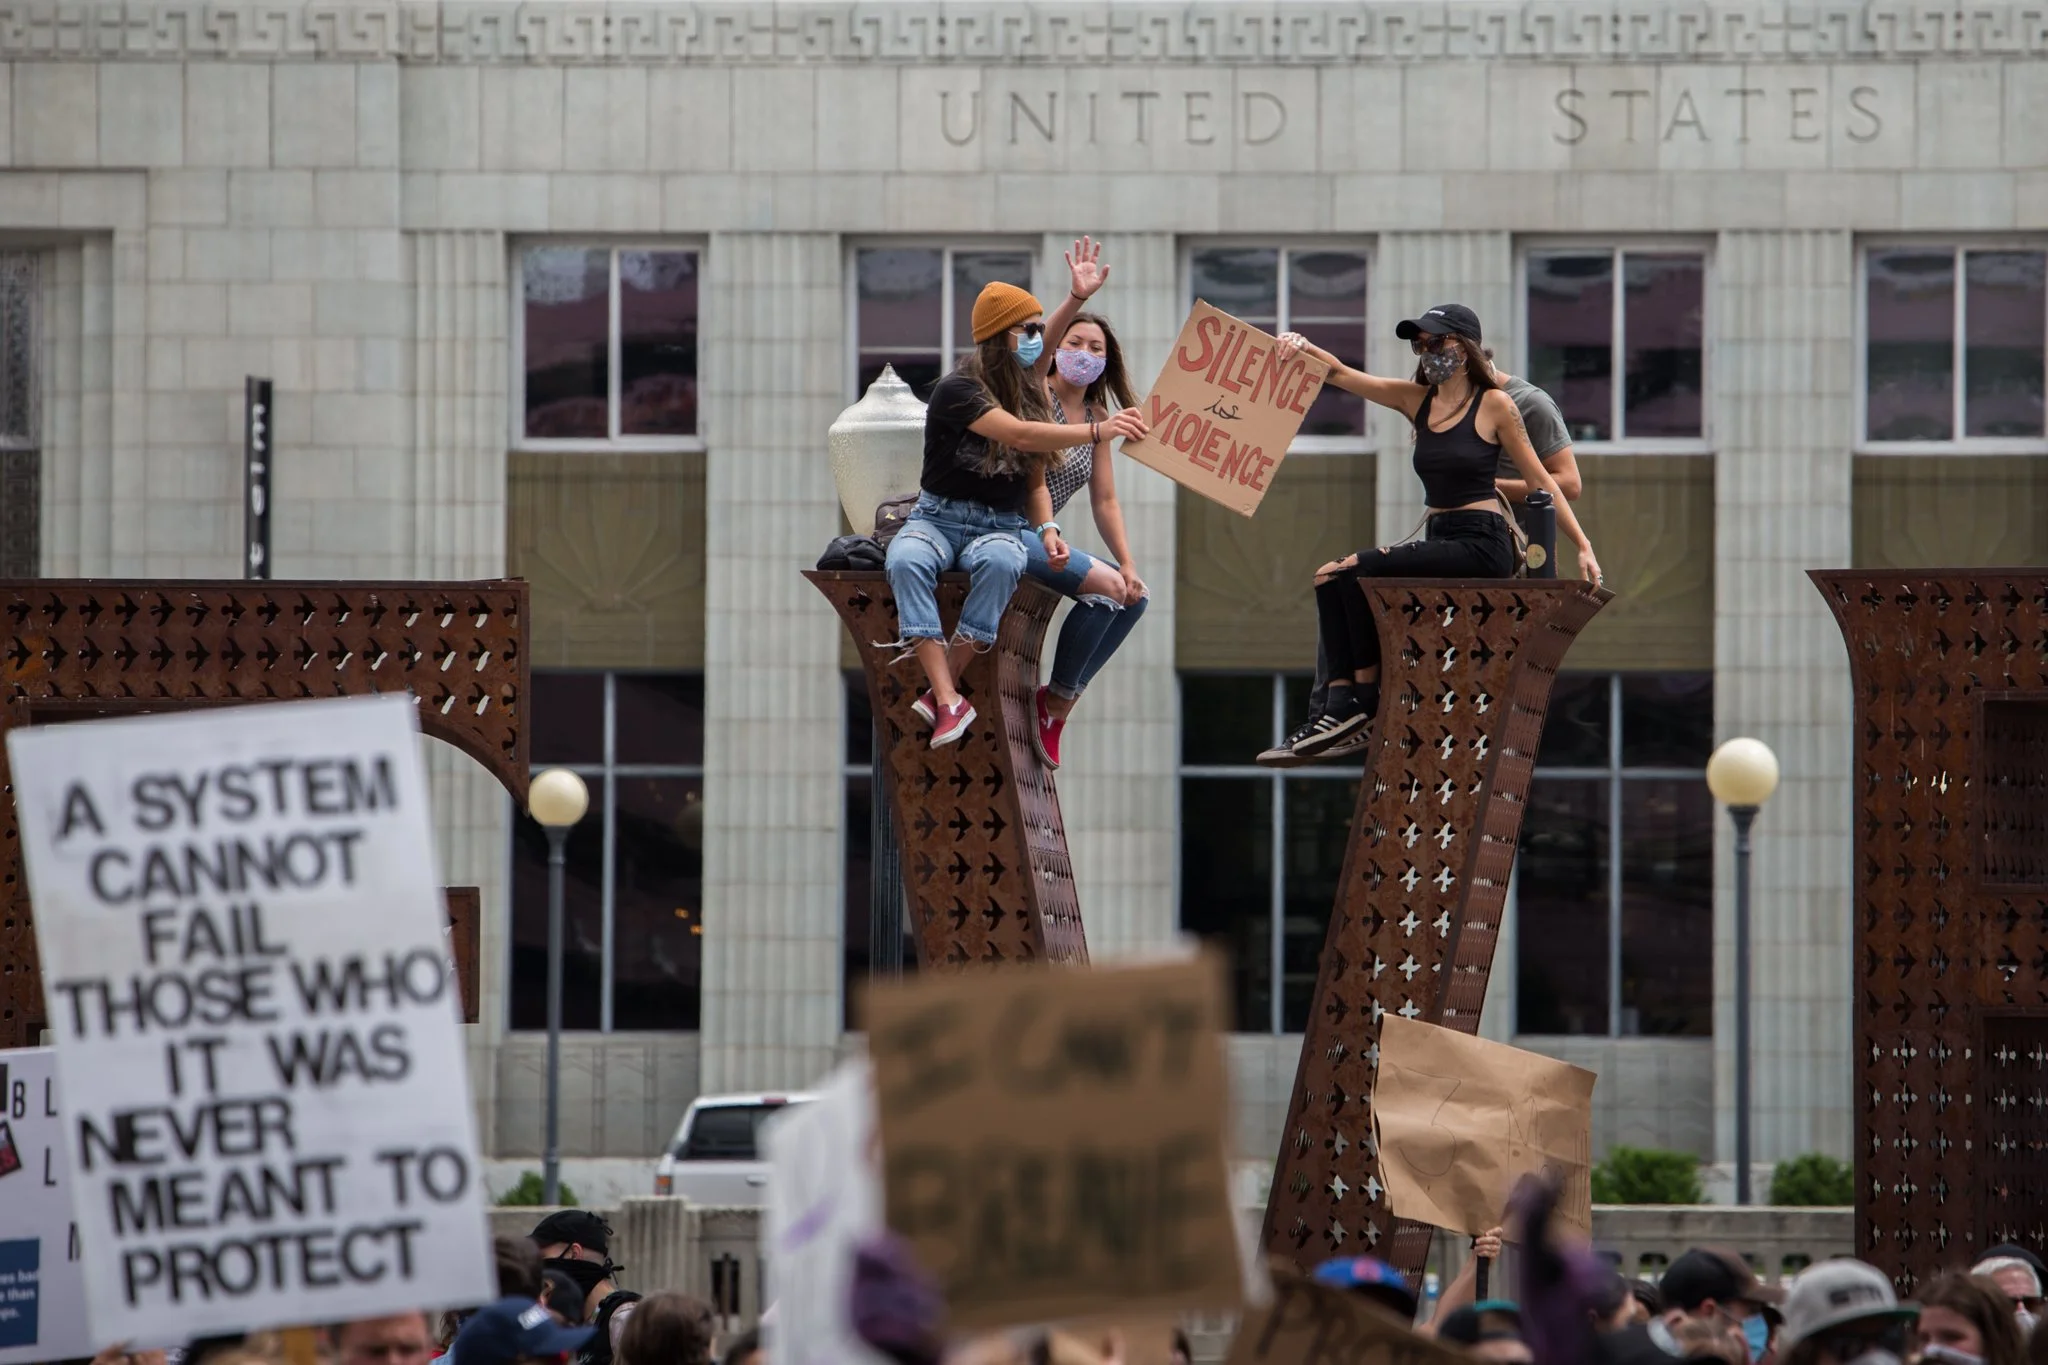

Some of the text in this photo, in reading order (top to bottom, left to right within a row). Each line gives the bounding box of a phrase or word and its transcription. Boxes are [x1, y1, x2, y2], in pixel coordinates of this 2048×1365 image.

[939, 86, 1883, 147] UNITED STATES
[1204, 395, 1243, 420] is
[58, 756, 398, 840] A SYSTEM
[88, 828, 364, 904] CANNOT
[140, 903, 288, 966] FAIL
[55, 946, 446, 1040] THOSE WHO
[163, 1022, 412, 1098] IT WAS
[76, 1098, 296, 1172] NEVER
[107, 1144, 468, 1238] MEANT TO
[119, 1220, 424, 1308] PROTECT
